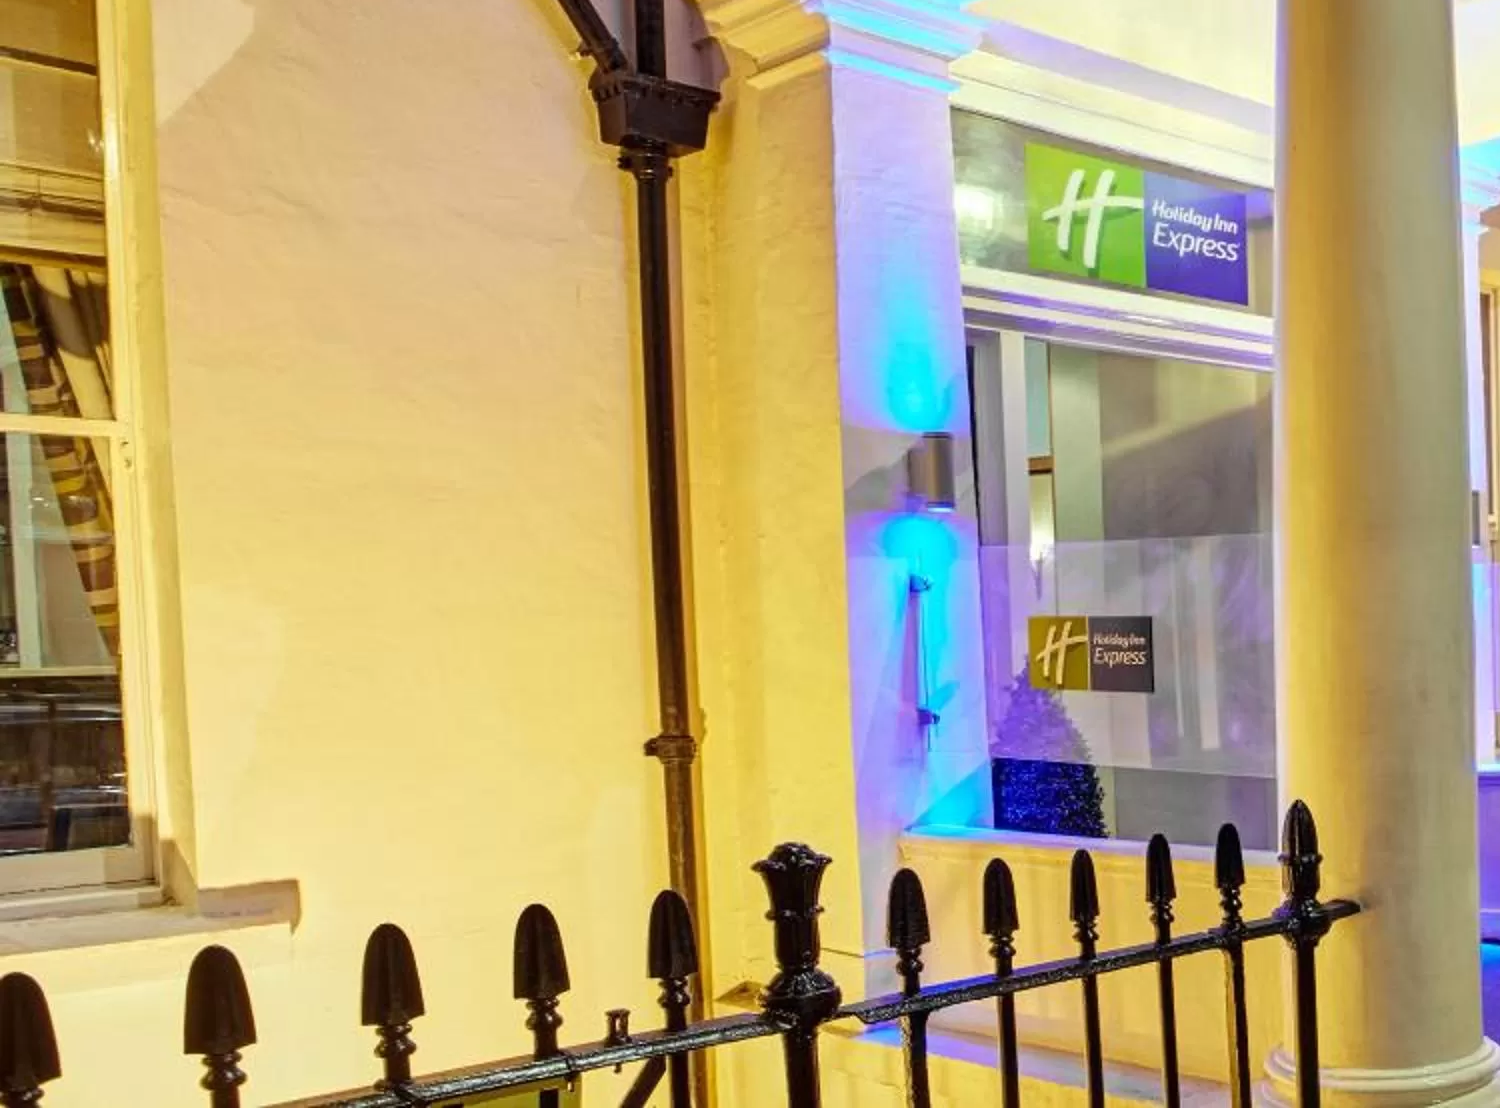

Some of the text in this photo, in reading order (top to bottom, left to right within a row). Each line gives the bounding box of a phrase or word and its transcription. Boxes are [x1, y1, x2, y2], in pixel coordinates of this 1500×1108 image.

[1152, 199, 1238, 235] Holiday Inn
[1152, 222, 1239, 261] Express
[1094, 633, 1129, 649] Holiday
[1094, 647, 1146, 668] Express
